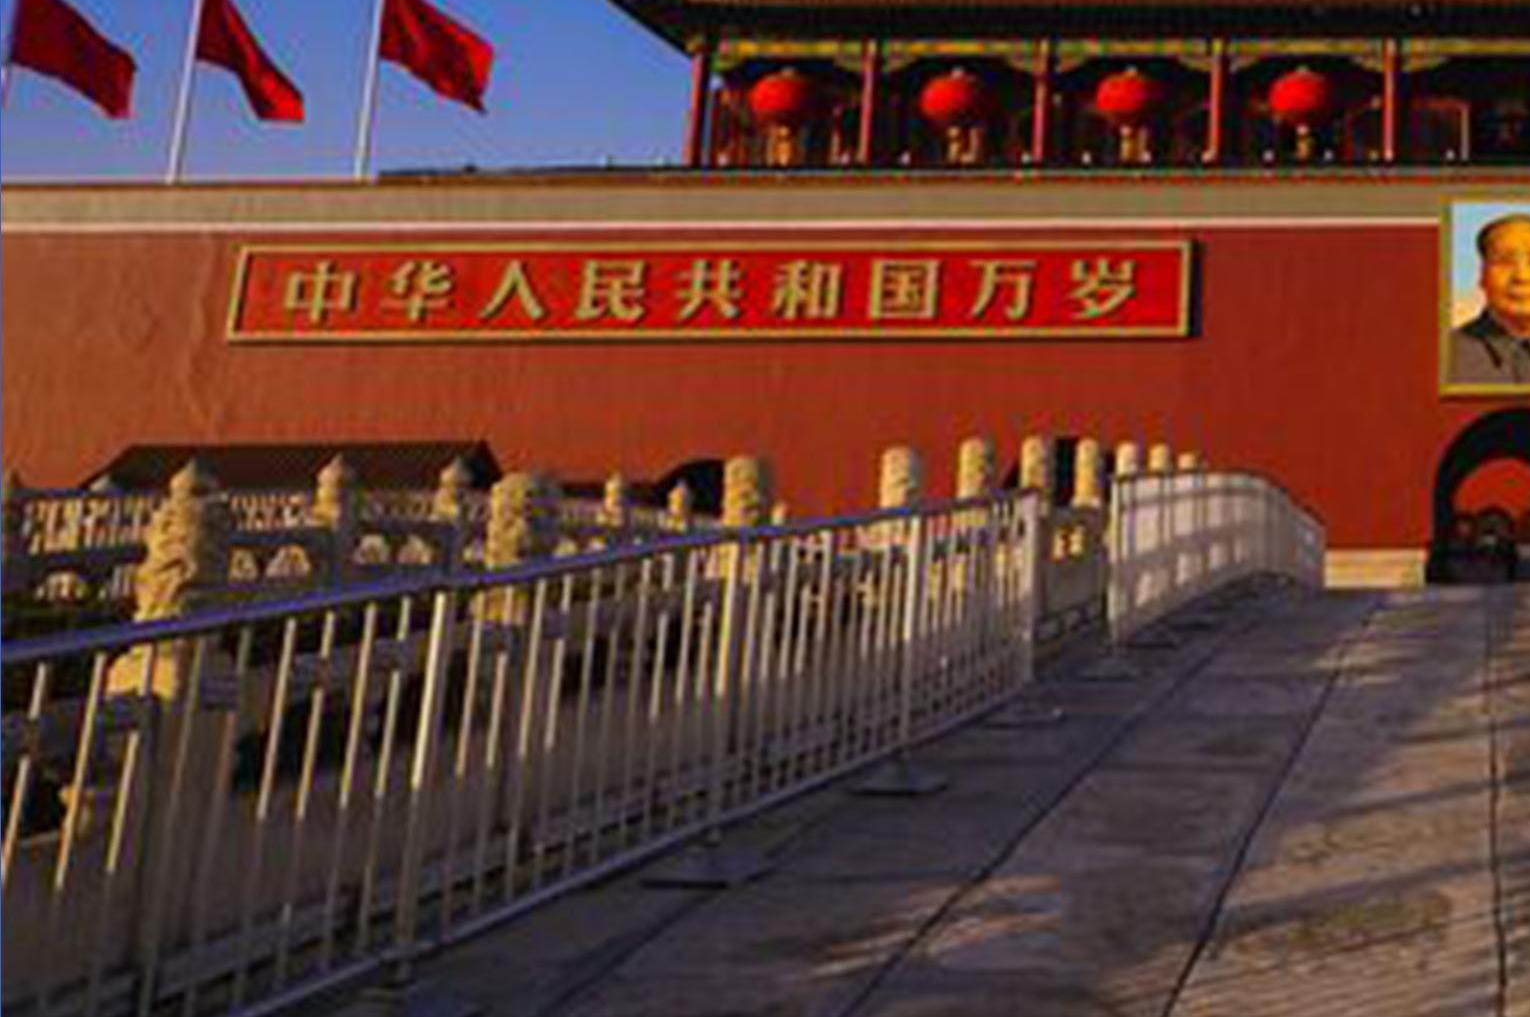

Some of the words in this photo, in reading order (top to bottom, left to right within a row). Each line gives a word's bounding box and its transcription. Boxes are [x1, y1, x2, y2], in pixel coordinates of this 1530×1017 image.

[282, 258, 1138, 322] 中华人民共和国万岁
